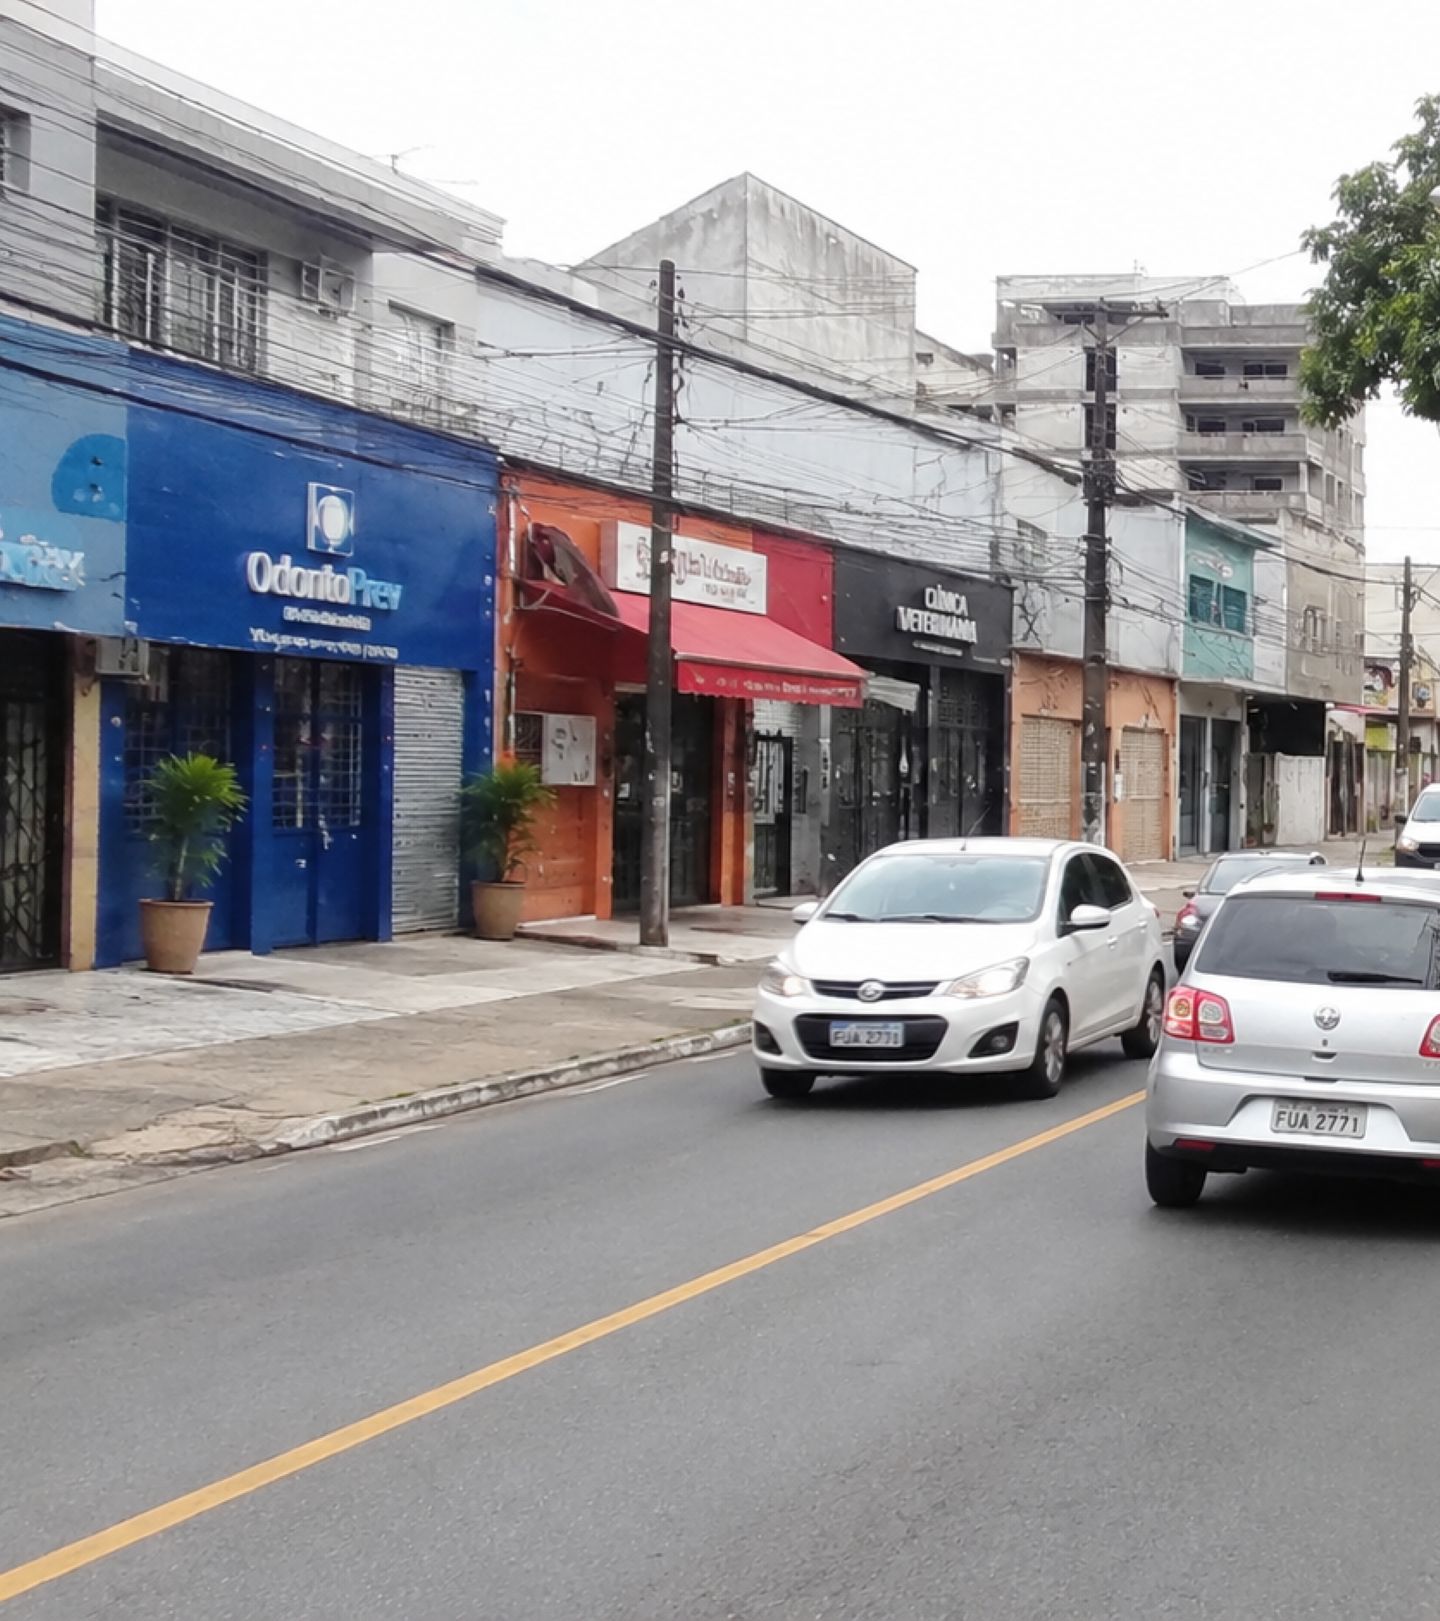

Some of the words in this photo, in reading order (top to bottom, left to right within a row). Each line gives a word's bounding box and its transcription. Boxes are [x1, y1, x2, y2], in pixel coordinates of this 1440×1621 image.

[246, 551, 403, 611] OdontoPrev
[1275, 1110, 1310, 1129] FUA
[1315, 1113, 1359, 1133] 2771
